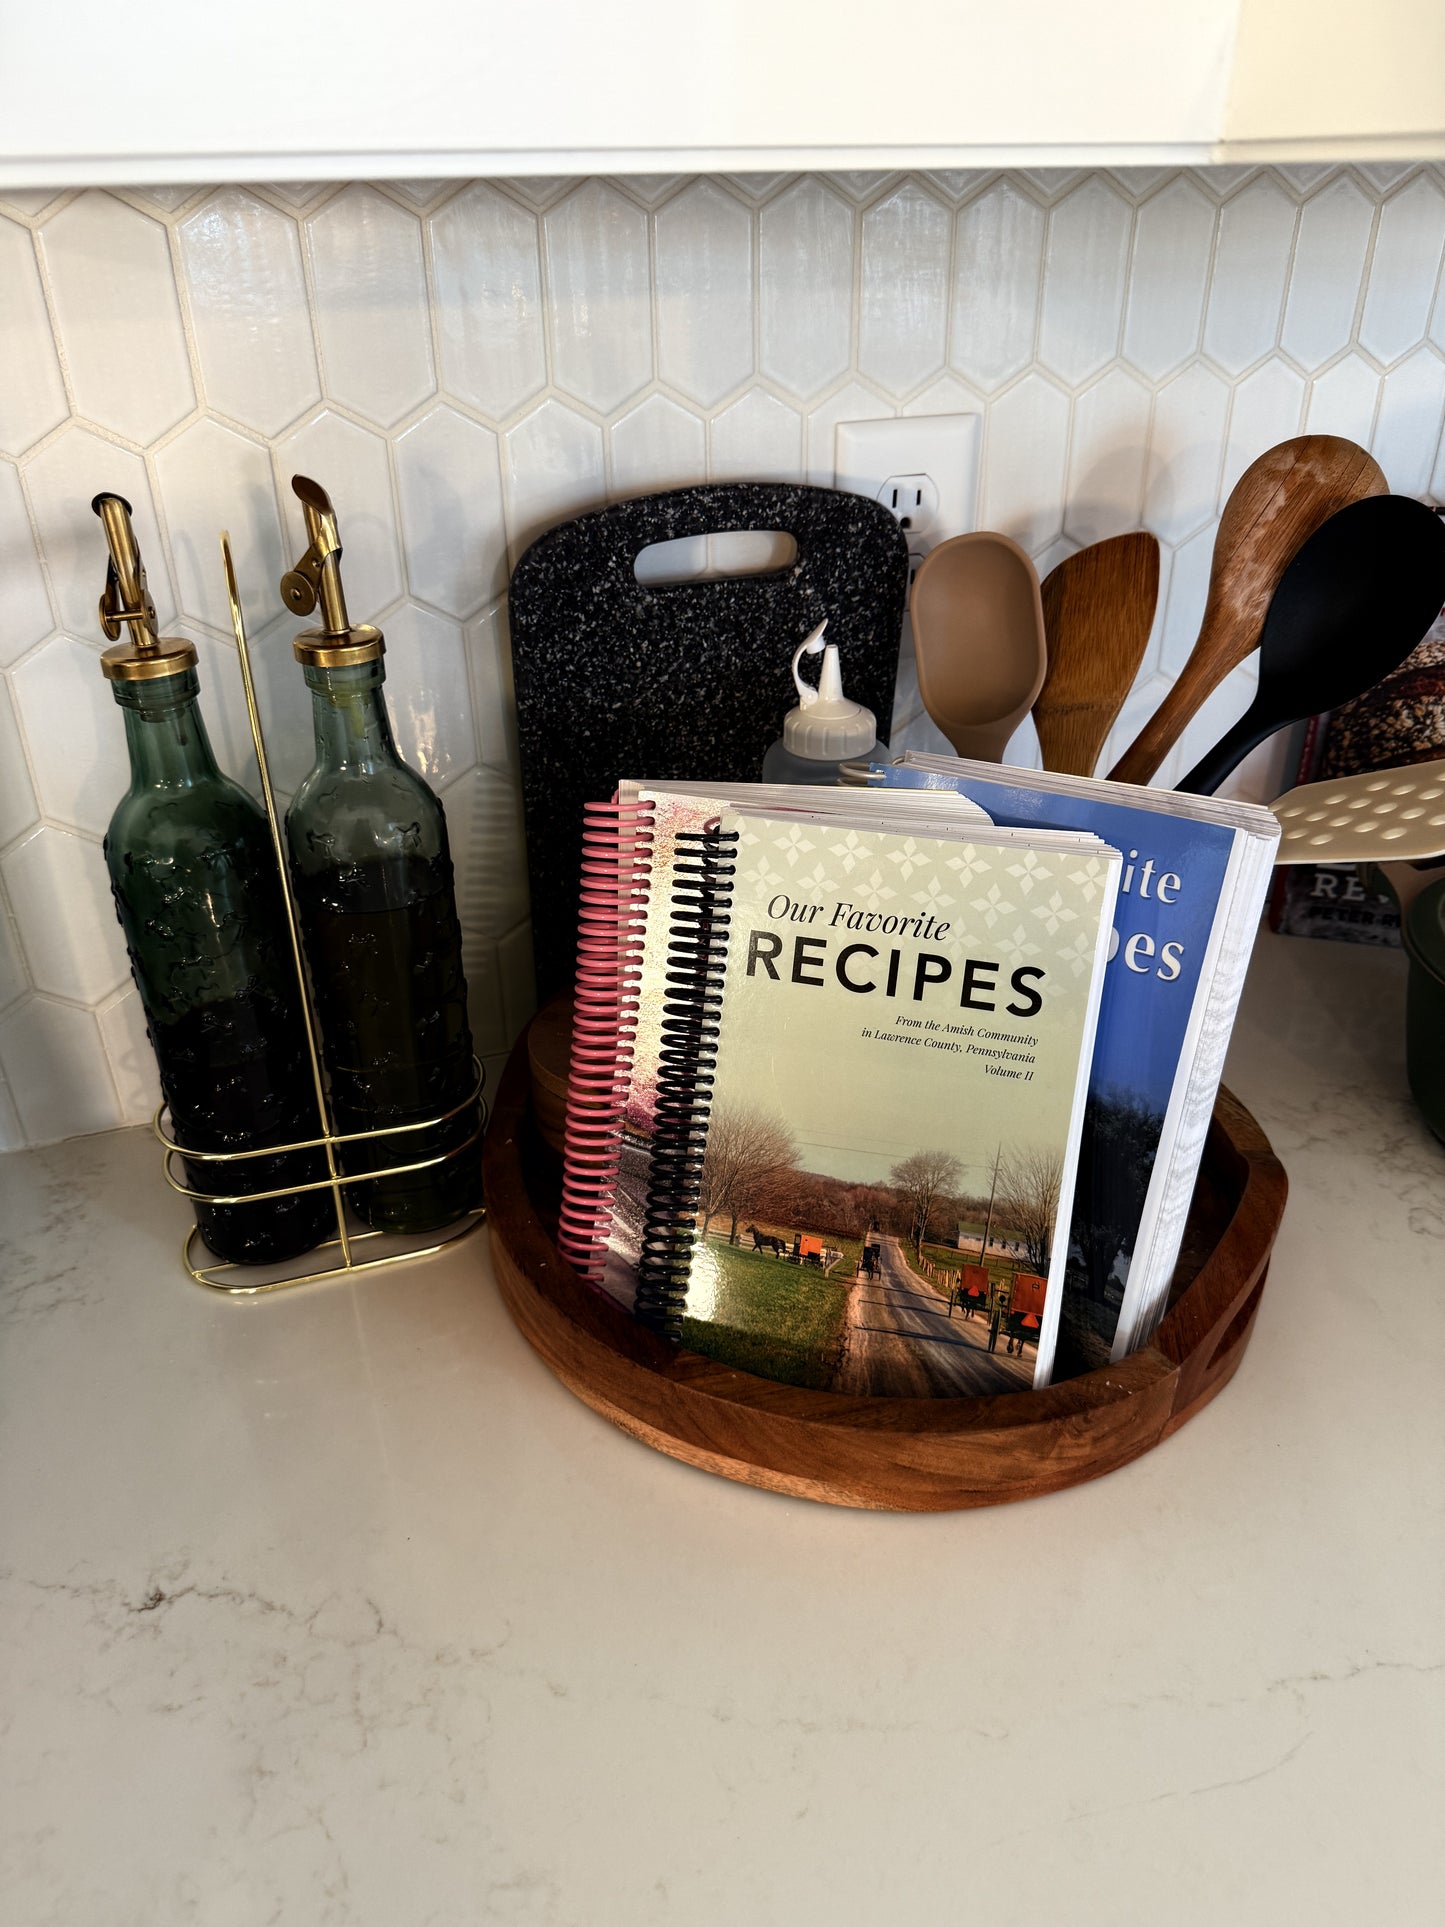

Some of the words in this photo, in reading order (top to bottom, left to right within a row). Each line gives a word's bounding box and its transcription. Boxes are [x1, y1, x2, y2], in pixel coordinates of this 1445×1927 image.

[1310, 872, 1390, 904] RE
[767, 894, 824, 923] Our
[829, 902, 951, 941] Favorite
[1308, 905, 1374, 925] PETER
[746, 929, 1047, 1018] RECIPES
[861, 1027, 873, 1038] in
[874, 1029, 922, 1046] Lawrence
[923, 1037, 963, 1053] County,
[965, 1043, 1036, 1063] Pennsylvania
[895, 1015, 922, 1029] From
[924, 1019, 941, 1031] the
[942, 1022, 974, 1036] Amish
[976, 1028, 1039, 1047] Community
[984, 1064, 1022, 1080] Volume
[1024, 1070, 1035, 1081] II
